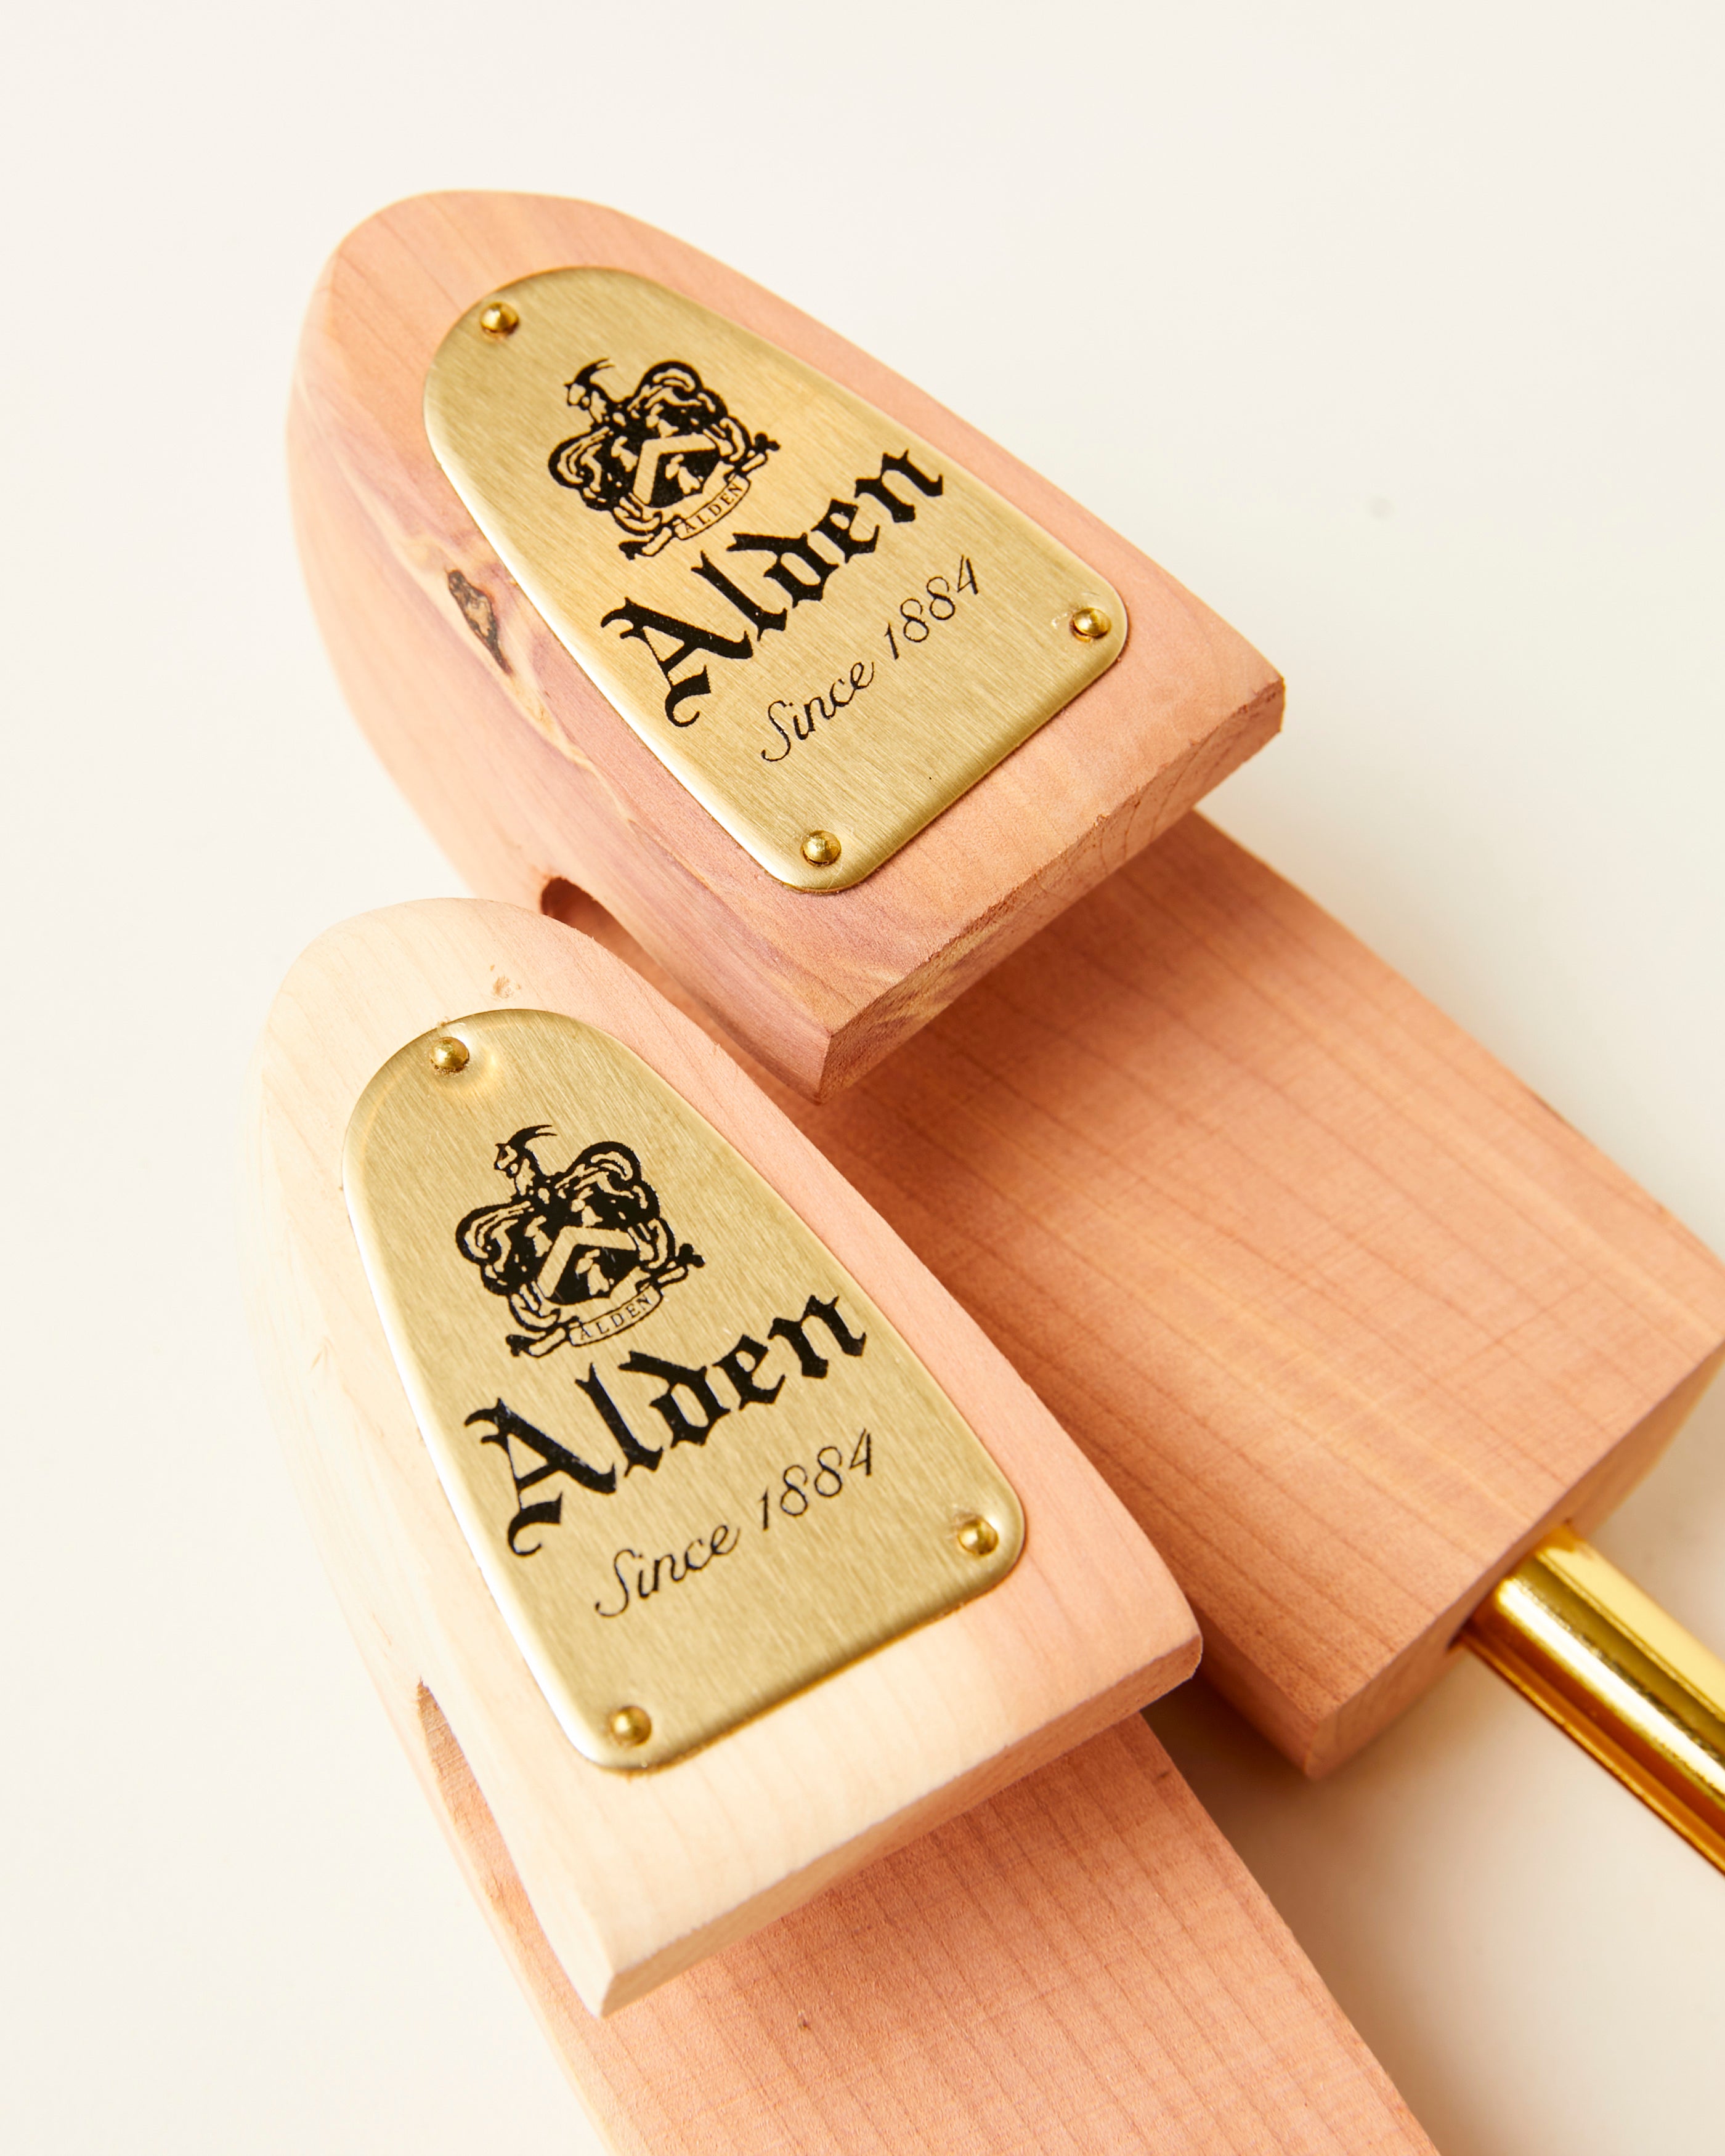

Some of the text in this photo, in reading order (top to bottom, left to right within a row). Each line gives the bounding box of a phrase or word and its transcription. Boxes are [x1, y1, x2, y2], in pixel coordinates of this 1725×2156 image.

[601, 449, 944, 727] Alden
[684, 482, 743, 533] ALDEN
[761, 556, 979, 761] Since 1884
[580, 1294, 652, 1340] ALDEN
[463, 1294, 866, 1557] Alden
[595, 1429, 872, 1616] Since 1884
